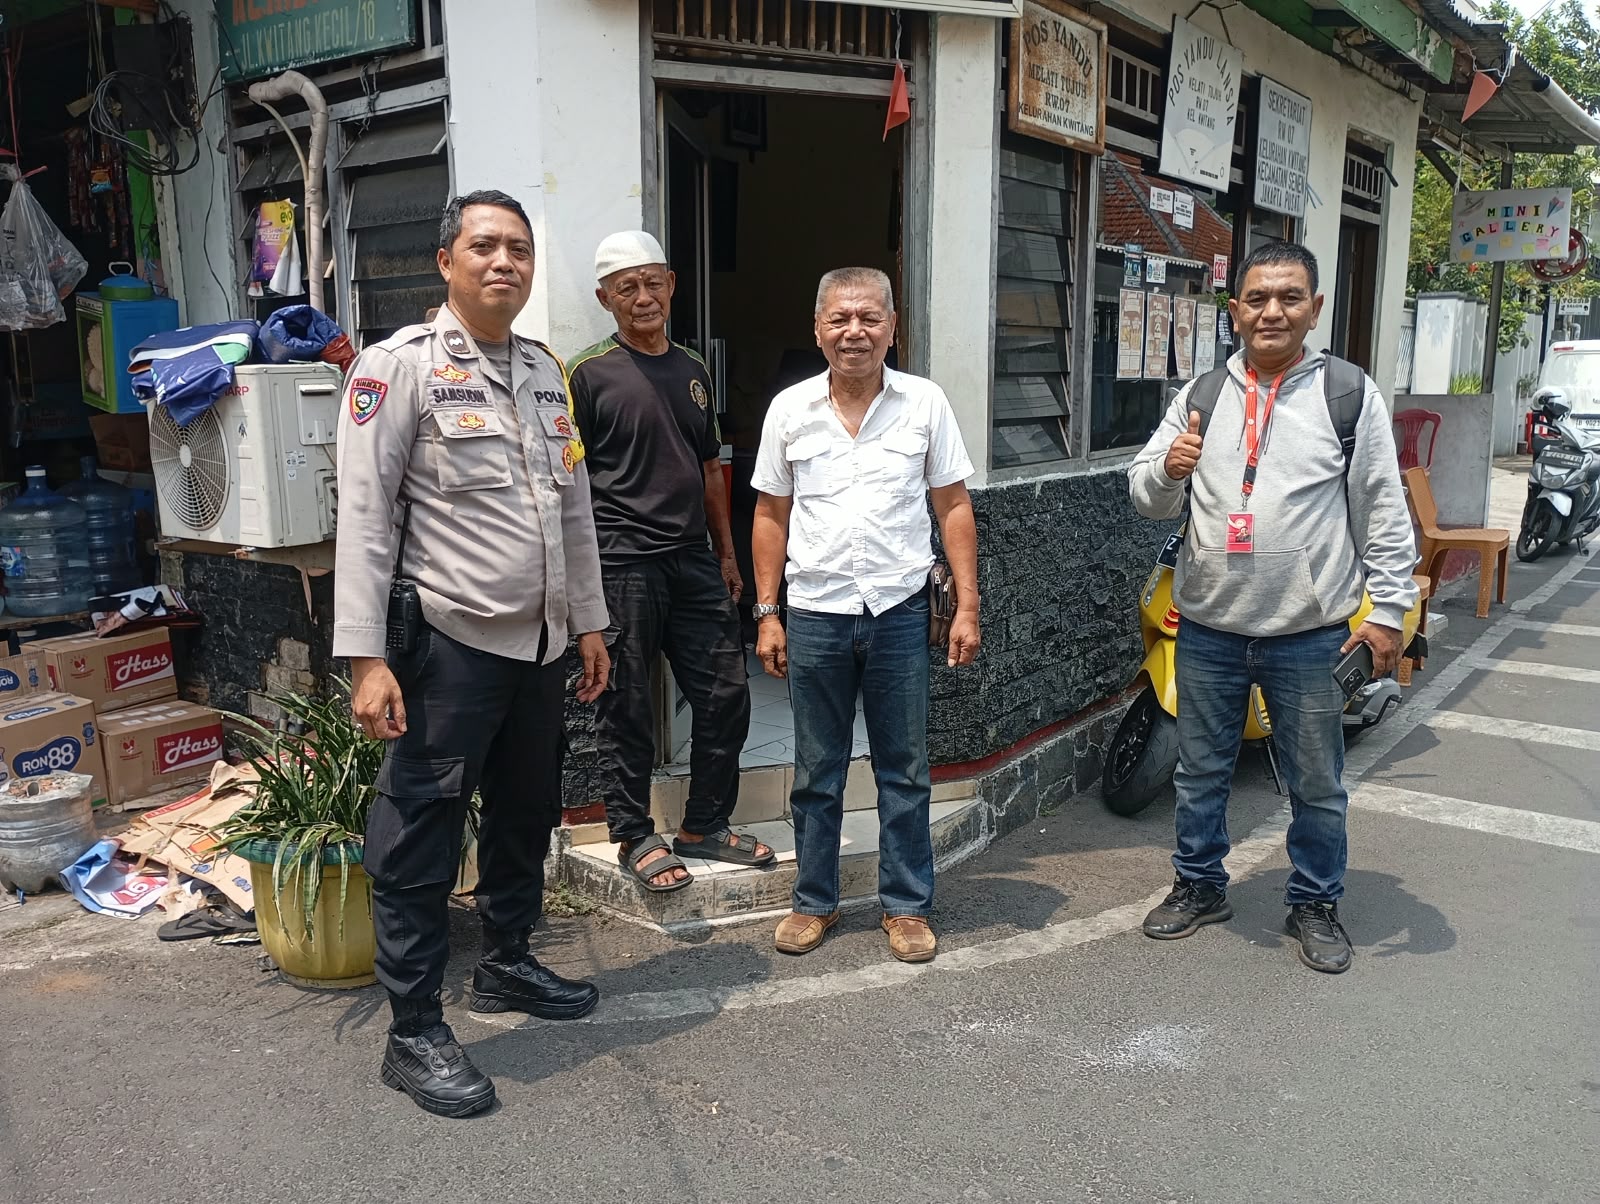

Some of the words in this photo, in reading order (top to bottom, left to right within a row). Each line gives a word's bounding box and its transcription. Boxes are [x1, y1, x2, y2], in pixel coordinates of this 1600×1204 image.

[1023, 20, 1048, 56] POS
[1053, 20, 1093, 78] YANDU
[1029, 63, 1058, 88] MELATI
[1061, 75, 1087, 99] TUJUH
[1168, 64, 1184, 106] POS
[1184, 36, 1214, 70] YANDU
[1216, 47, 1234, 126] LANSIA
[1018, 102, 1062, 127] KELURAHAN
[1063, 117, 1094, 136] KWITANG
[1268, 89, 1306, 126] SEKRETARIAT
[1278, 120, 1286, 141] RW
[1288, 125, 1295, 144] 07
[1259, 137, 1287, 167] KELURAHAN
[1288, 148, 1306, 174] KWITANG
[1257, 159, 1288, 188] KECAMATAN
[1288, 172, 1305, 194] SENEN
[1260, 184, 1282, 207] JAKARTA
[1285, 191, 1300, 212] PUSAT
[1487, 205, 1540, 217] MINI
[1462, 221, 1559, 242] GALLERY
[356, 380, 383, 391] BINMAS
[432, 387, 487, 404] SAMSUDIN
[0, 676, 14, 687] RO
[116, 653, 169, 682] Hass
[165, 736, 219, 764] Hass
